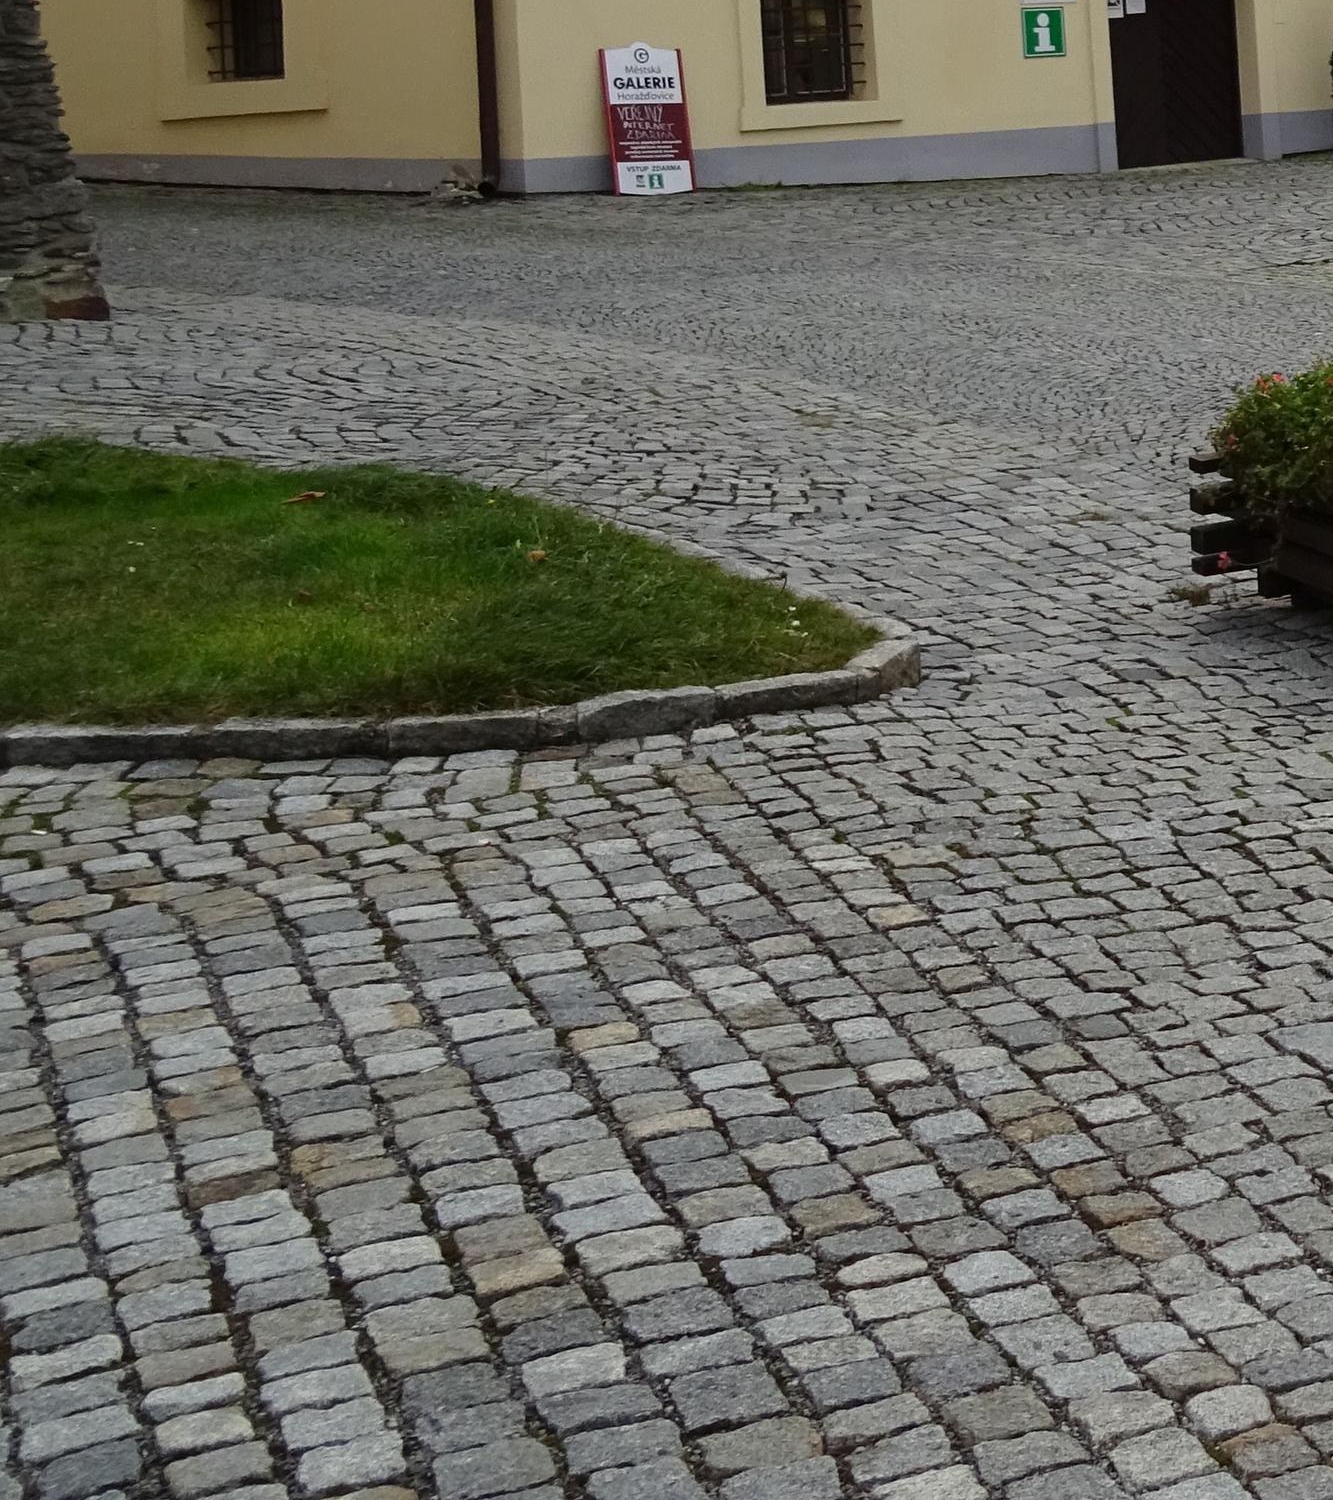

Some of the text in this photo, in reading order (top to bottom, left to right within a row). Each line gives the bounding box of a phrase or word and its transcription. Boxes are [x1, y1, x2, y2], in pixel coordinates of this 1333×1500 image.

[625, 65, 661, 74] Městská
[613, 77, 675, 90] GALERIE
[617, 92, 674, 101] Horažďovice
[626, 165, 649, 173] VSTUP
